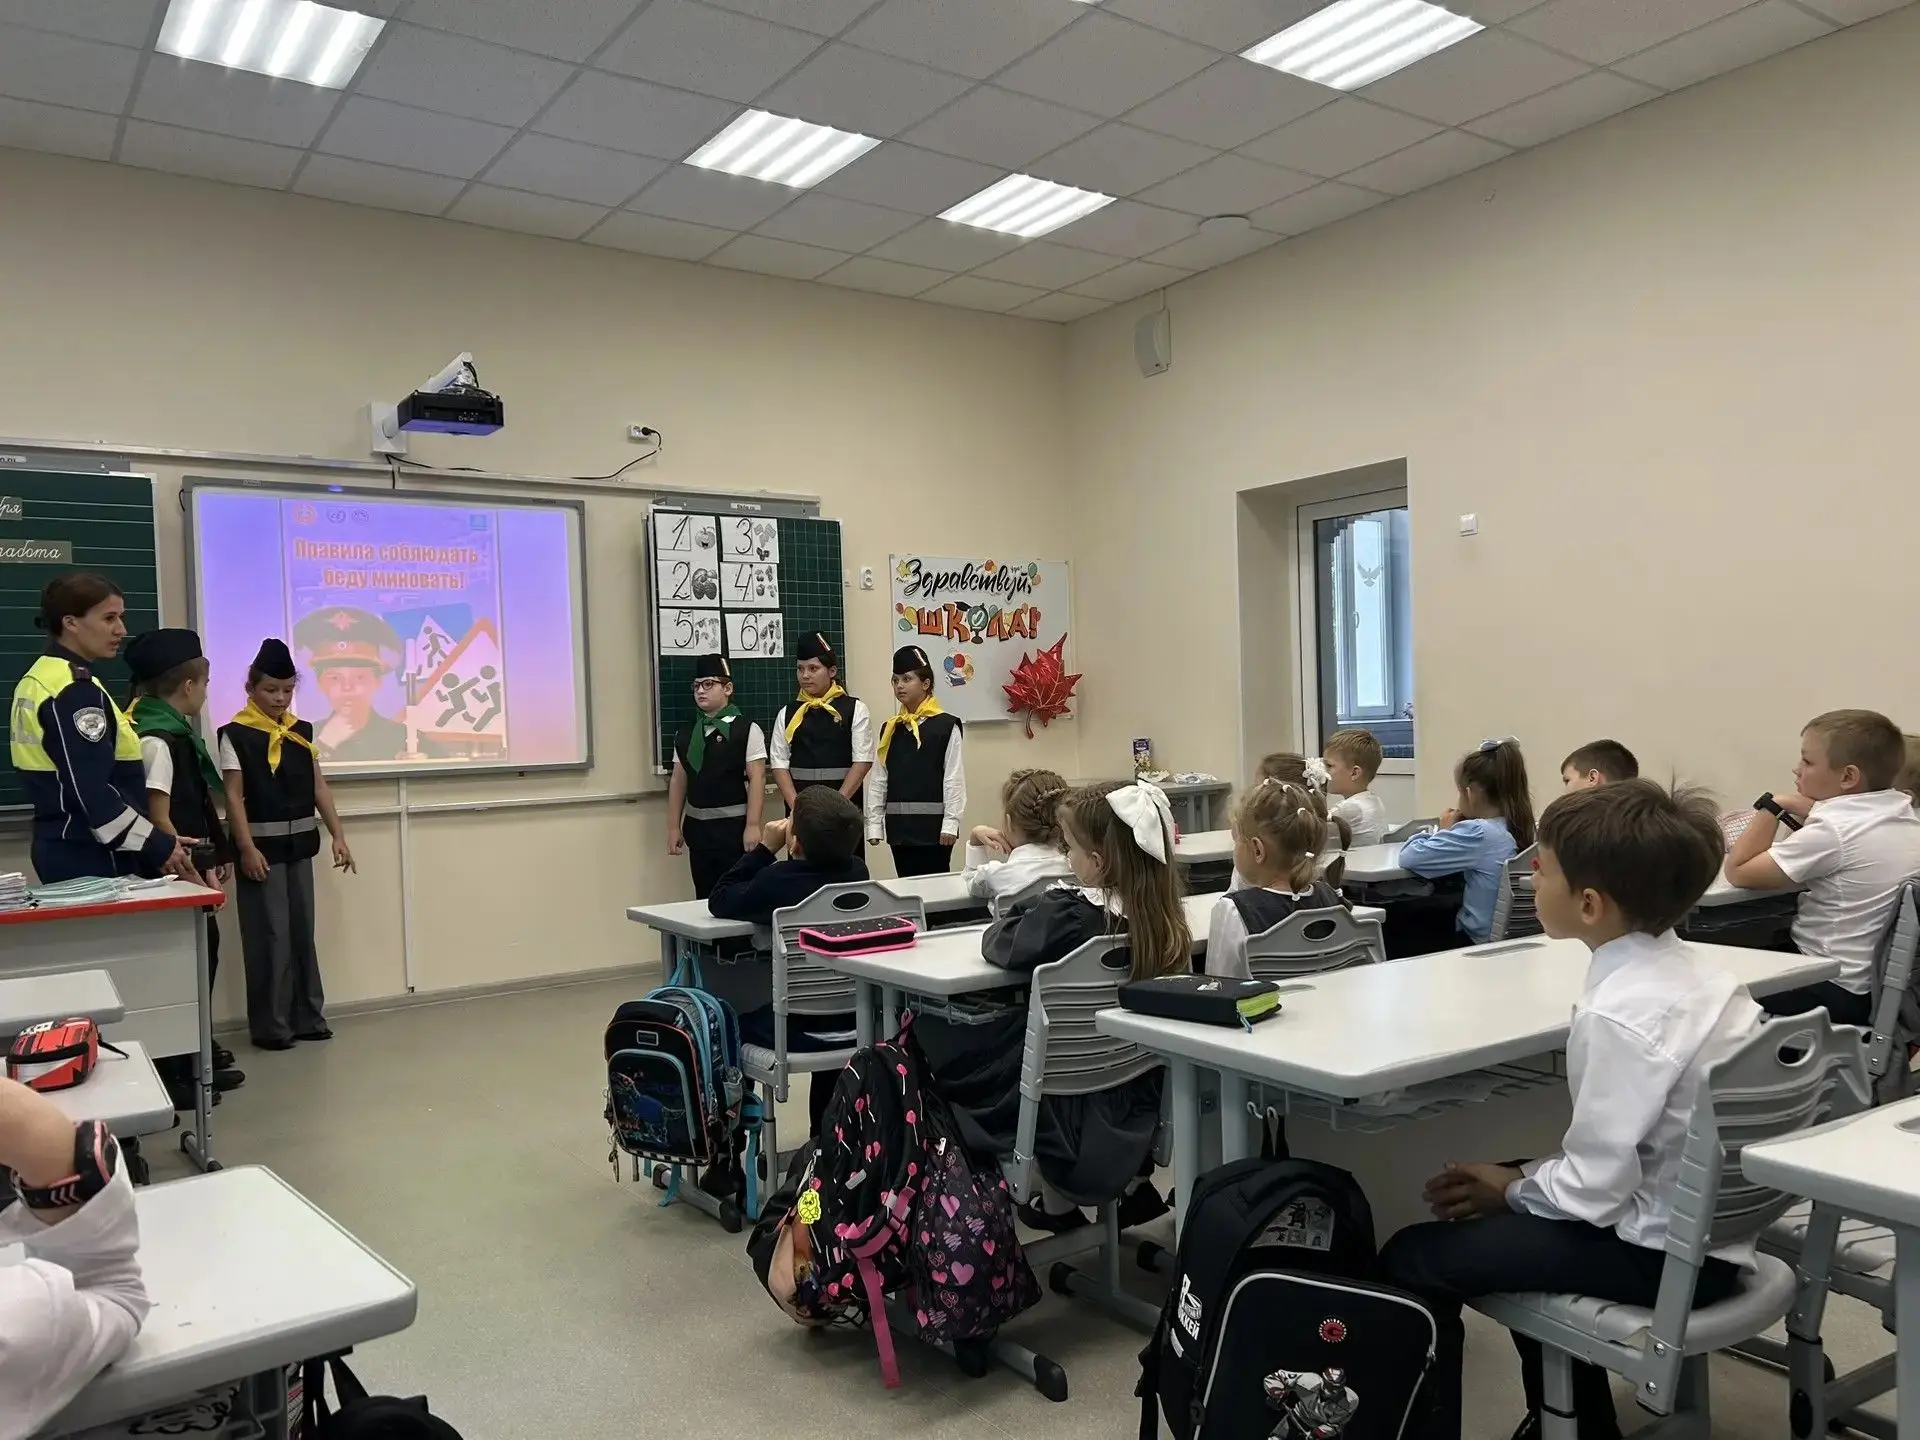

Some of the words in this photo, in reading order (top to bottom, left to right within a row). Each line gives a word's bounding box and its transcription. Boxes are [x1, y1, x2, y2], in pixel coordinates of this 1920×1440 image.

[672, 515, 689, 550] 1
[735, 518, 752, 554] 3
[295, 539, 374, 562] Правила
[379, 543, 478, 564] соблюдать
[324, 569, 368, 589] беду
[372, 571, 465, 589] миновать!
[672, 561, 690, 599] 2
[735, 563, 752, 601] 4
[674, 610, 694, 648] 5
[741, 613, 758, 650] 6
[917, 602, 1038, 644] ШКОЛА!
